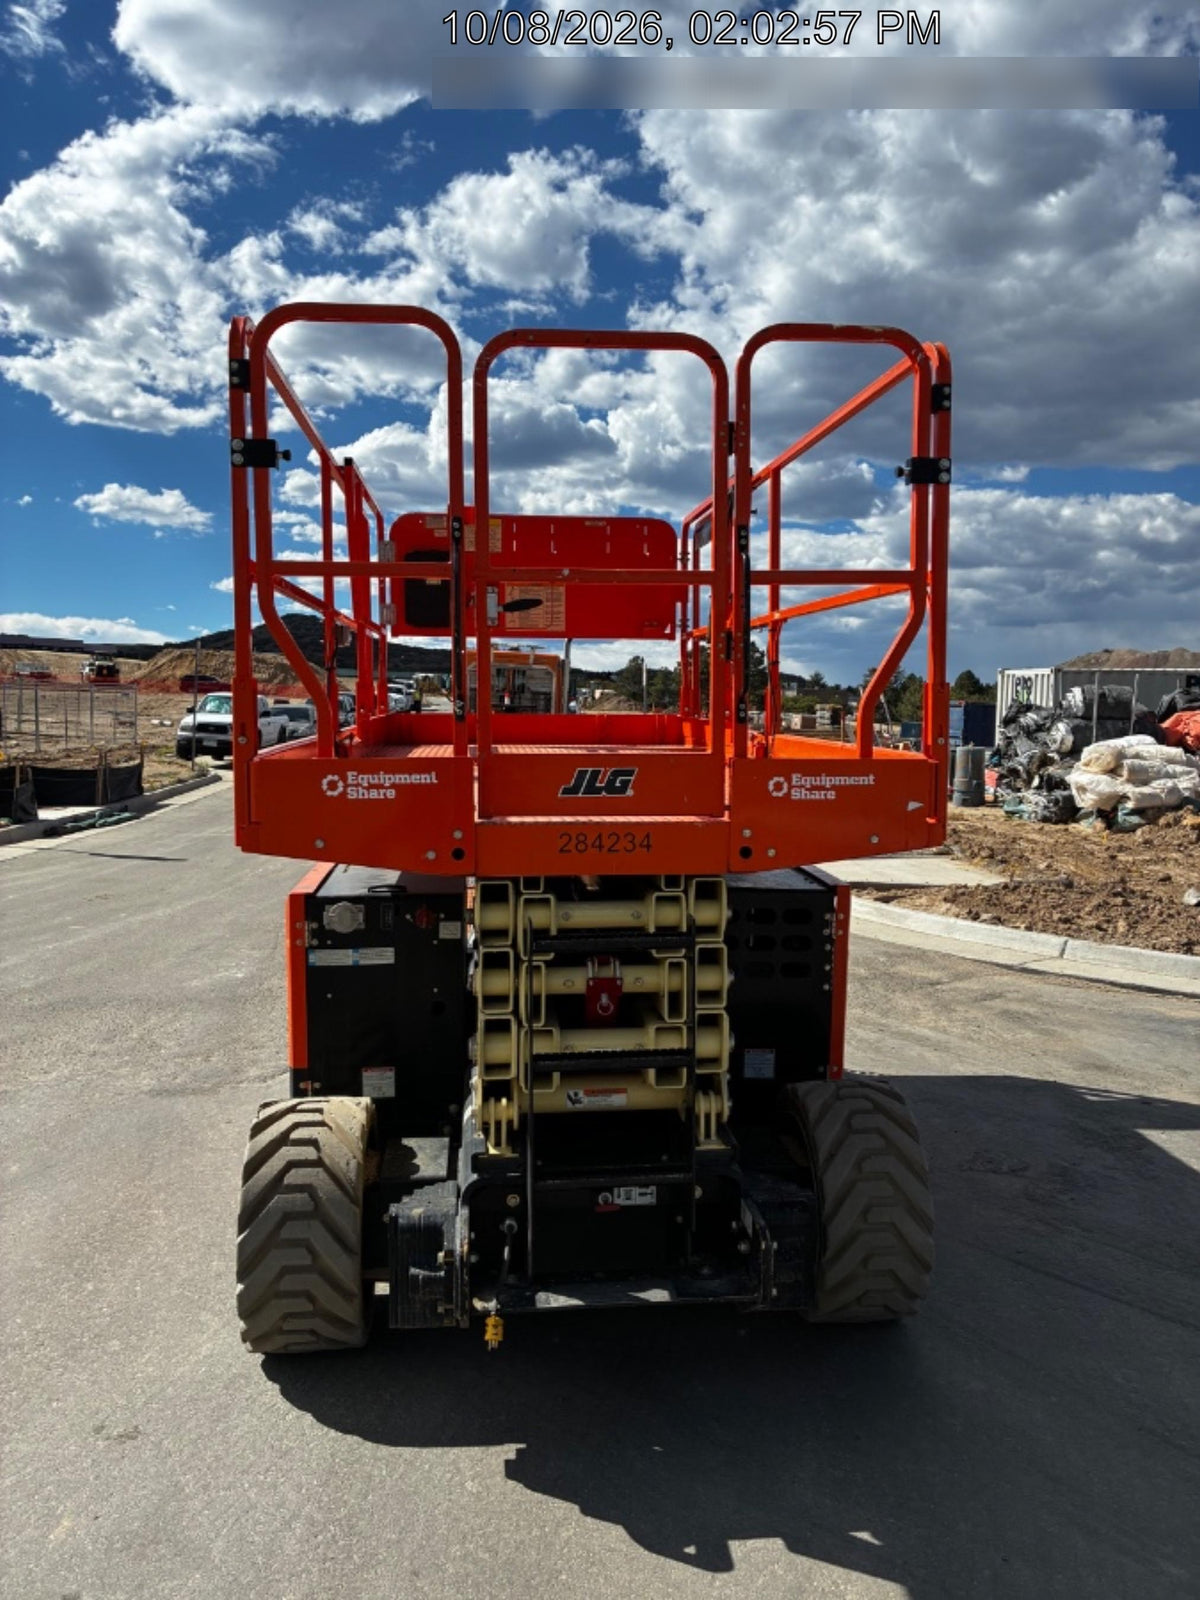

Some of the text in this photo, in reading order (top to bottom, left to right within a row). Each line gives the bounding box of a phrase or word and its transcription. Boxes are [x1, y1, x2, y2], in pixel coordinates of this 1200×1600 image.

[346, 771, 438, 787] Equipment
[558, 767, 638, 797] JLG
[790, 773, 876, 788] Equipment
[346, 786, 396, 799] Share
[790, 787, 837, 800] Share
[558, 832, 652, 854] 284234
